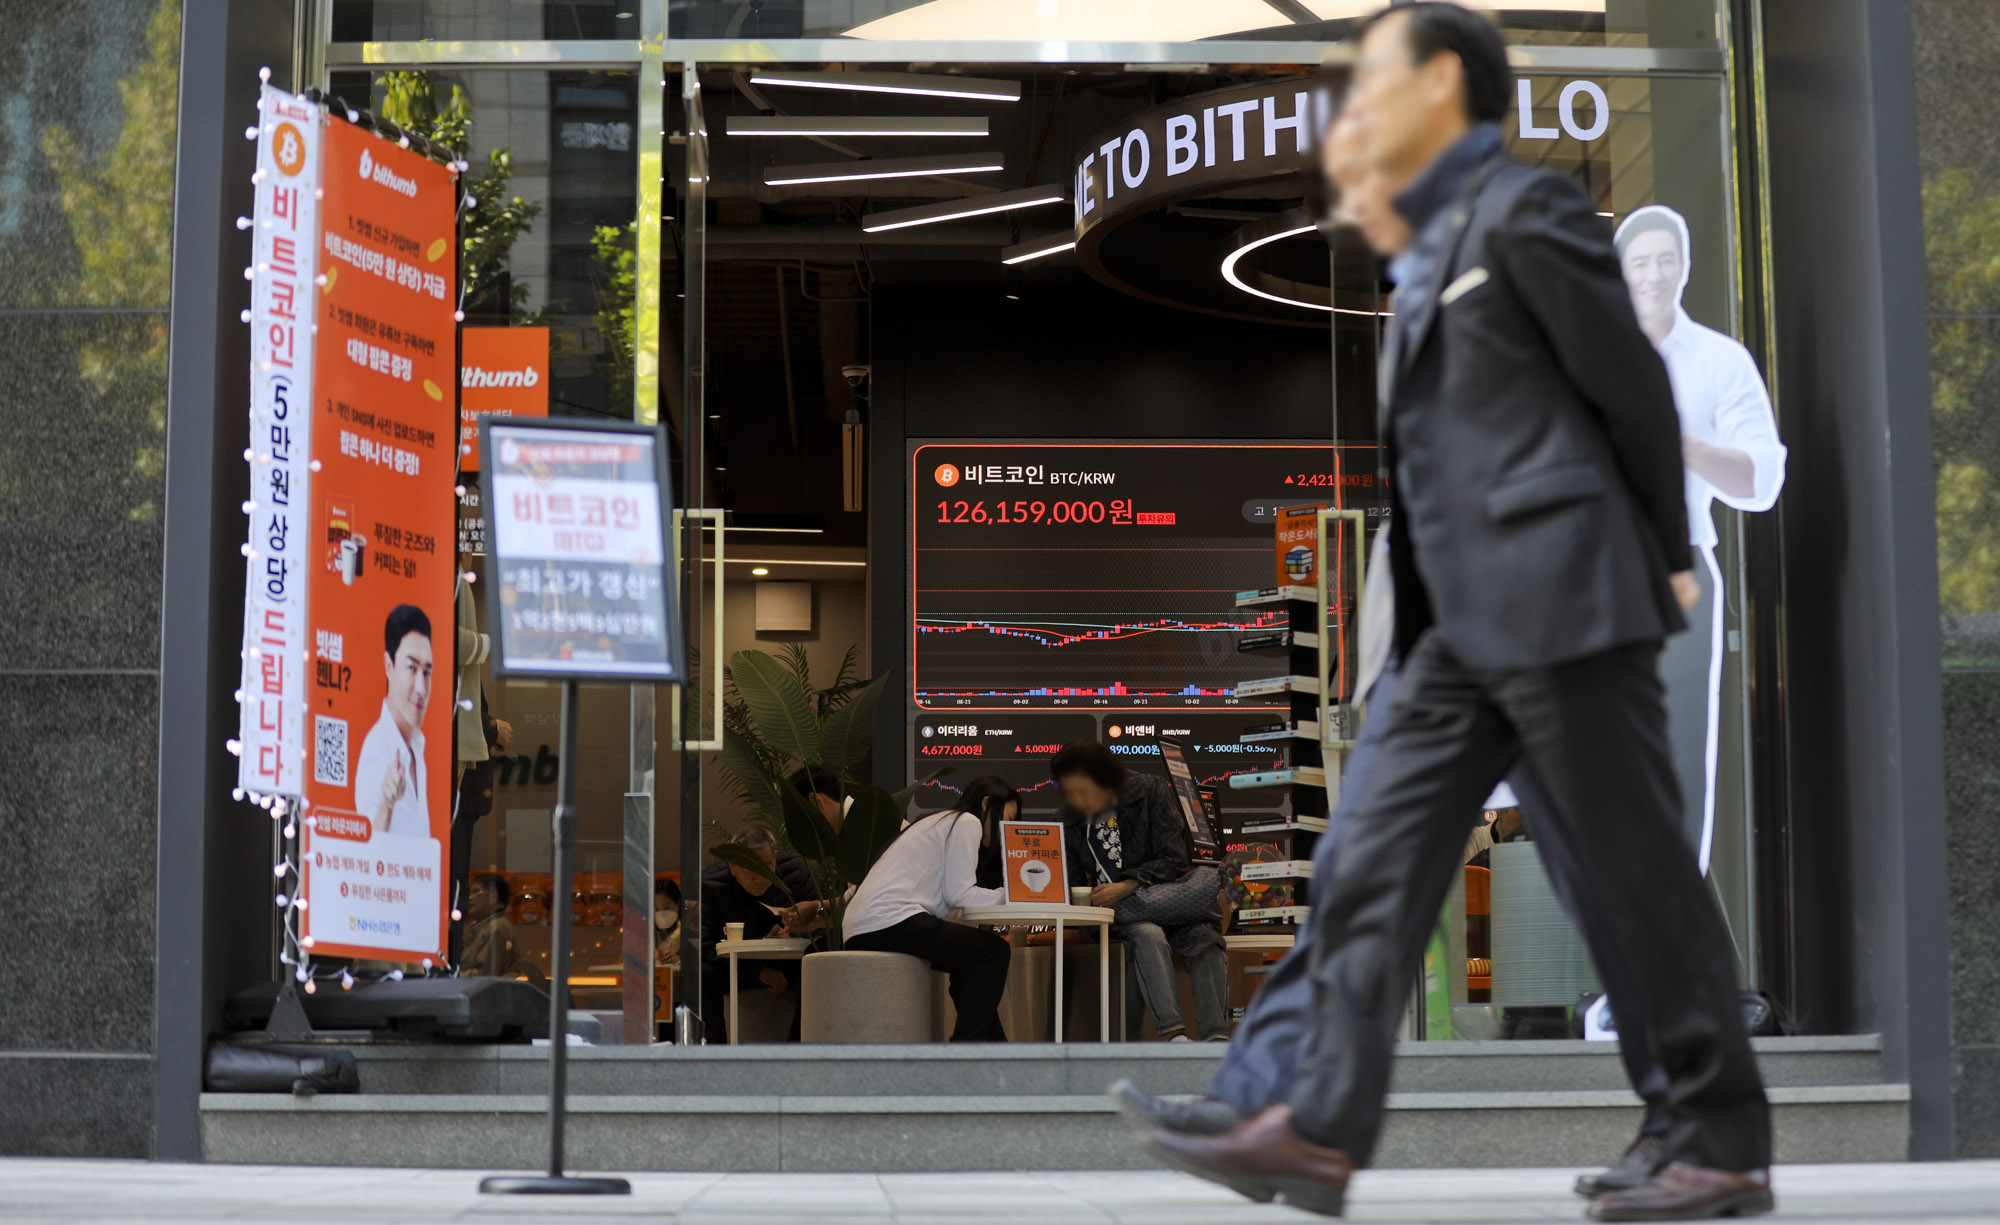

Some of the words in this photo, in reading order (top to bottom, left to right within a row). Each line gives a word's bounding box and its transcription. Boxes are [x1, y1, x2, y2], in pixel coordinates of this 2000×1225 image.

[1100, 128, 1150, 199] TO
[1166, 91, 1331, 177] BITH
[1517, 79, 1610, 141] LO
[373, 163, 418, 198] bithumb
[348, 214, 354, 230] 1.
[374, 225, 388, 245] 신규
[391, 231, 421, 258] 가입하면
[325, 231, 384, 277] 비트코인(5만
[398, 263, 422, 293] 상당)
[424, 273, 446, 300] 지급
[329, 304, 335, 319] 2.
[355, 314, 377, 336] 회원은
[379, 322, 401, 346] 유튜브
[403, 331, 435, 358] 구독하면
[347, 338, 368, 367] 대형
[391, 353, 413, 382] 증정
[461, 366, 539, 387] thumb
[336, 401, 350, 421] 개인
[351, 408, 375, 430] SNS에
[377, 416, 392, 435] 사진
[393, 422, 435, 449] 업로드하면
[340, 430, 358, 458] 팝콘
[360, 437, 380, 466] 하나
[382, 445, 393, 470] 더
[394, 448, 420, 476] 증정!
[965, 464, 1044, 485] 비트코인
[1050, 471, 1115, 486] BTC/KRW
[513, 492, 640, 530] 비트코인
[1138, 513, 1175, 524] 투자유의
[374, 522, 402, 549] 푸짐한
[404, 531, 435, 556] 굿즈와
[374, 552, 400, 576] 커피는
[403, 560, 417, 579] 덤!
[316, 628, 343, 663] 빗썸
[938, 725, 978, 737] 이더리움
[1125, 725, 1155, 736] 비앤비
[921, 745, 983, 756] 4,677,000원
[1008, 850, 1028, 858] HOT
[1032, 849, 1060, 860] 커피존
[1022, 838, 1041, 848] 무료
